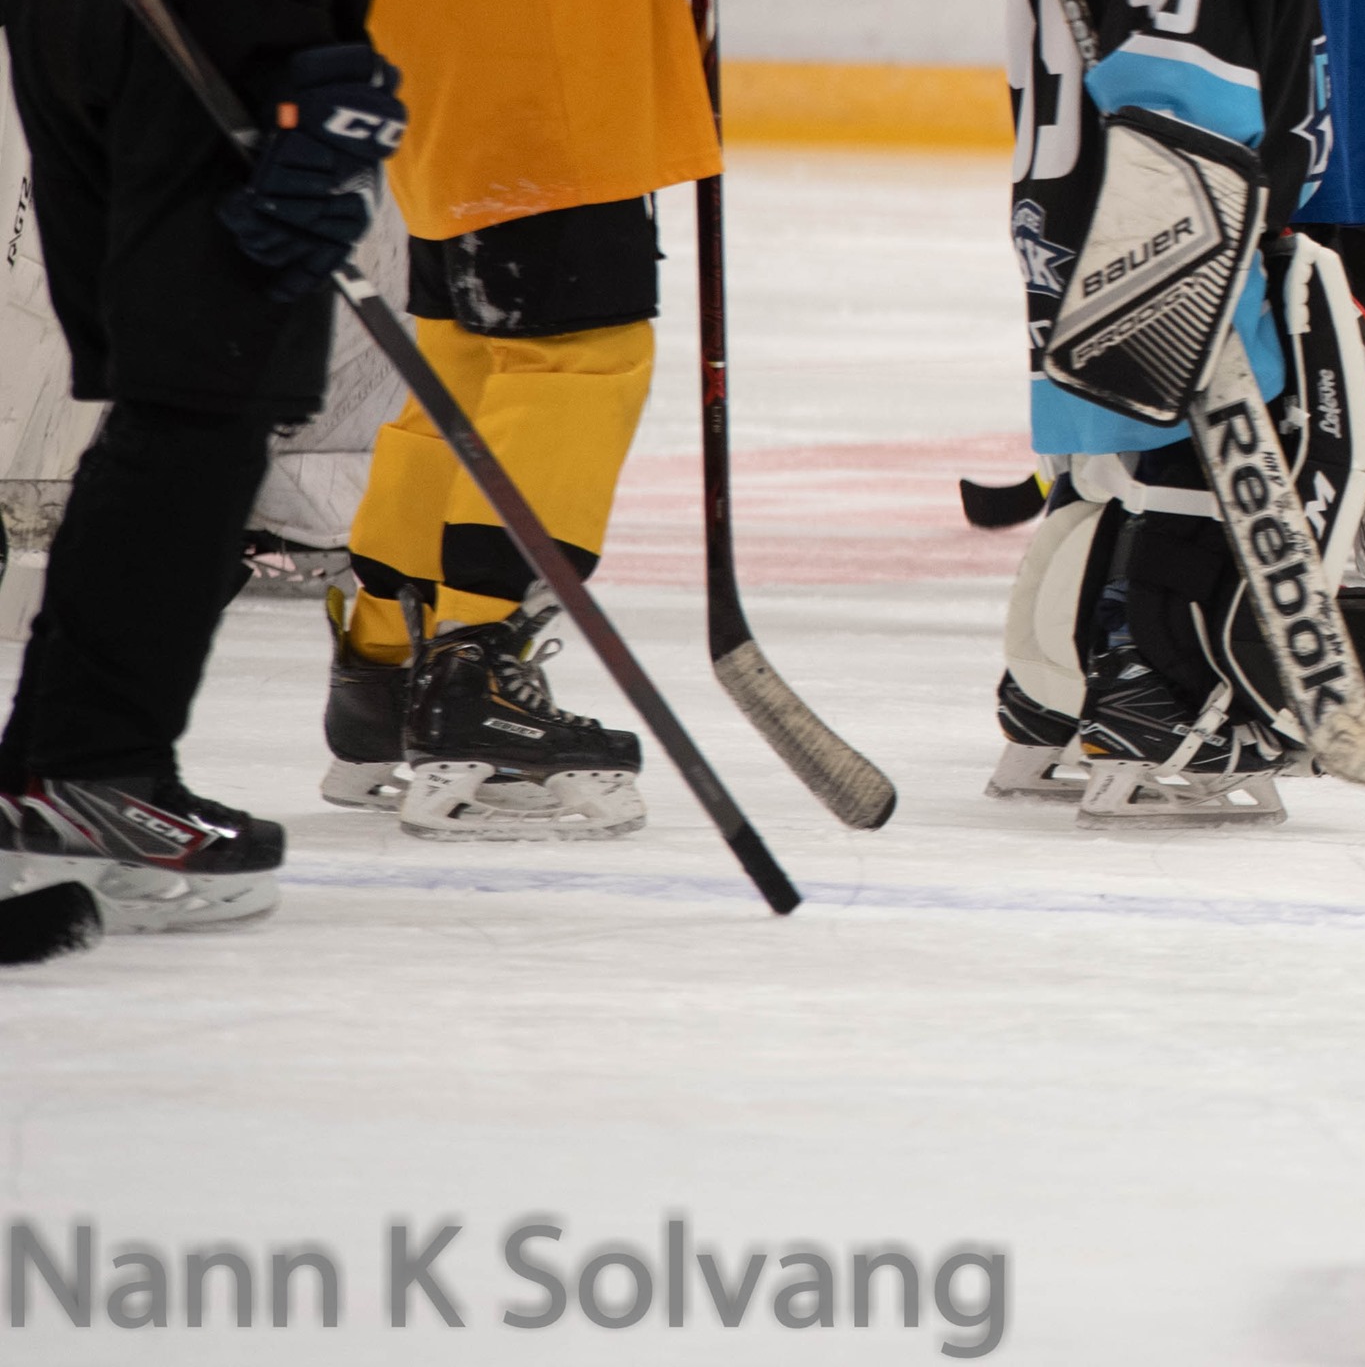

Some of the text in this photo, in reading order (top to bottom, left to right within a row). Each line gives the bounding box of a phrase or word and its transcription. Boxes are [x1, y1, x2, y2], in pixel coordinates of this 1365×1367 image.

[1081, 216, 1196, 298] BAUER
[1204, 397, 1348, 727] Reebok
[124, 805, 196, 846] CCM
